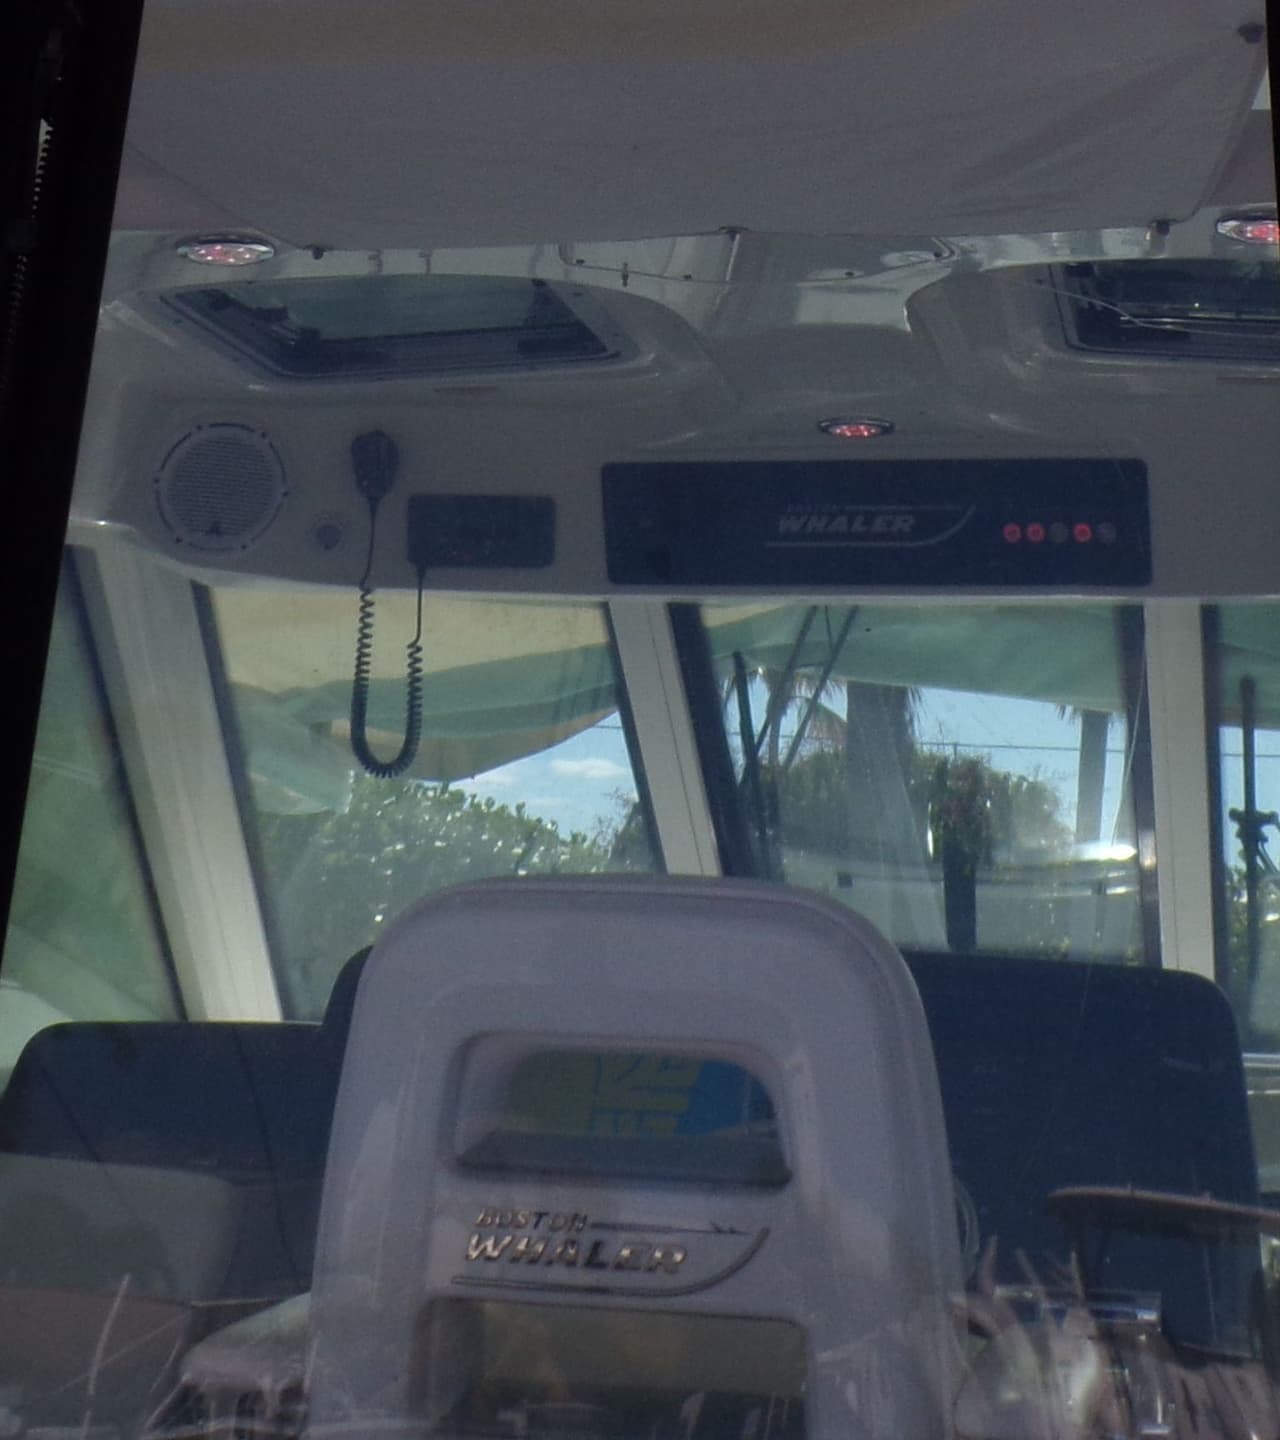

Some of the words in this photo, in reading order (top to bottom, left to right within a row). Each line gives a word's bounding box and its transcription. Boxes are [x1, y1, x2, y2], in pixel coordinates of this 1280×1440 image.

[777, 513, 916, 535] WHALER
[474, 1206, 589, 1233] BOSTON
[464, 1232, 688, 1275] WHALER
